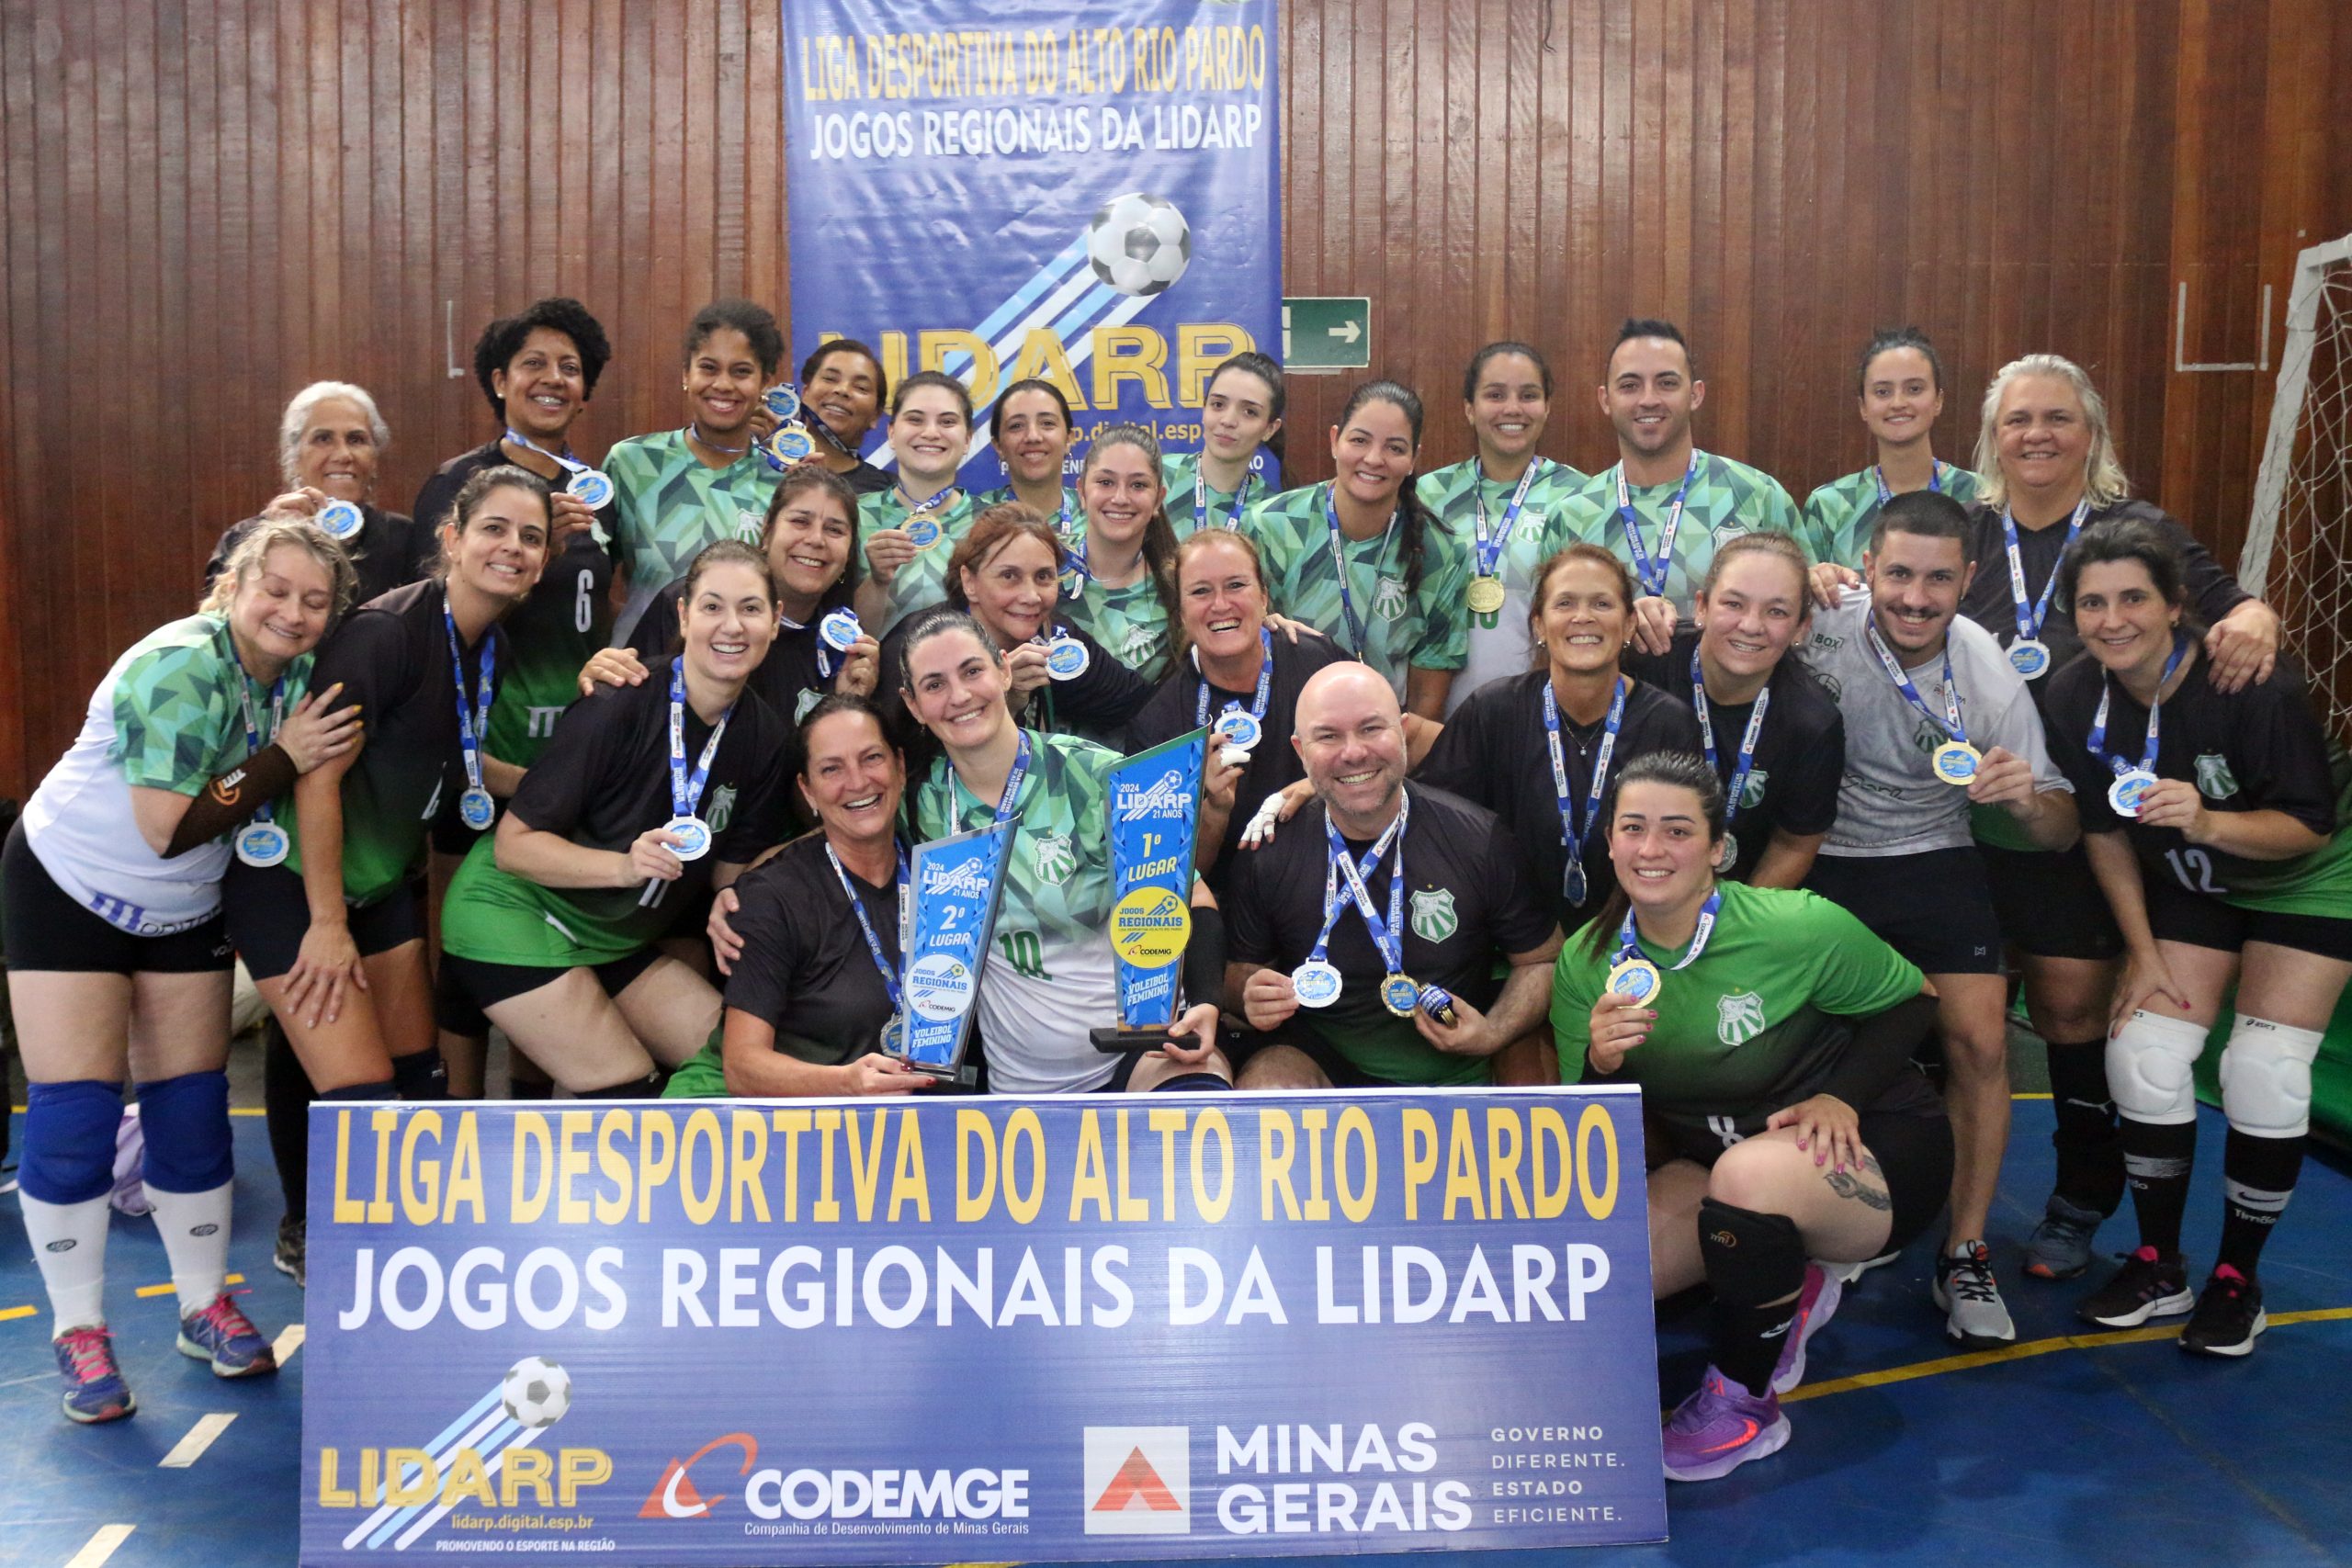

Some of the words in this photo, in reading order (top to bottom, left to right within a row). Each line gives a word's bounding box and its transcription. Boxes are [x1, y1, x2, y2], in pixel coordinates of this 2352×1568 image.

[803, 35, 860, 101] LIGA
[866, 28, 1017, 99] DESPORTIVA
[1023, 28, 1058, 96] DO
[1067, 28, 1126, 95] ALTO
[1134, 26, 1177, 92] RIO
[1185, 24, 1266, 91] PARDO
[810, 111, 914, 160] JOGOS
[924, 105, 1091, 156] REGIONAIS
[1102, 104, 1145, 151] DA
[1154, 103, 1261, 150] LIDARP
[575, 569, 594, 633] 6
[1008, 773, 1016, 787] ALTO
[1014, 767, 1023, 782] LIGA
[1003, 780, 1020, 815] DESPORTIVA
[1120, 784, 1139, 793] 2024
[999, 795, 1009, 813] PARDO
[1117, 793, 1192, 809] LIDARP
[1152, 809, 1161, 818] 21
[1162, 809, 1182, 818] ANOS
[926, 862, 944, 872] 2024
[1127, 856, 1178, 882] LUGAR
[1341, 860, 1355, 881] CODEMIG
[2165, 849, 2227, 894] 12
[922, 870, 989, 891] LIDARP
[953, 888, 960, 897] 21
[961, 889, 979, 899] ANOS
[1353, 888, 1366, 908] GERAIS
[1357, 886, 1369, 904] MINAS
[1118, 917, 1182, 927] REGIONAIS
[929, 932, 971, 947] LUGAR
[1697, 922, 1706, 945] CODEMIG
[999, 931, 1053, 982] 10
[1375, 934, 1395, 966] REGIONAIS
[913, 967, 935, 976] JOGOS
[912, 976, 967, 991] REGIONAIS
[1128, 973, 1169, 995] VOLEIBOL
[1127, 983, 1169, 1007] FEMININO
[929, 1004, 956, 1012] CODEMIG
[914, 1024, 952, 1039] VOLEIBOL
[2254, 1021, 2277, 1031] asics
[912, 1034, 952, 1048] FEMININO
[333, 1109, 486, 1226] LIGA
[511, 1107, 932, 1226] DESPORTIVA
[956, 1107, 1046, 1224] DO
[1069, 1107, 1235, 1224] ALTO
[1260, 1105, 1377, 1223] RIO
[1402, 1104, 1619, 1222] PARDO
[339, 1246, 628, 1331] JOGOS
[662, 1245, 1134, 1329] REGIONAIS
[1169, 1244, 1288, 1325] DA
[1317, 1243, 1611, 1325] LIDARP
[1491, 1426, 1603, 1442] GOVERNO
[1217, 1422, 1438, 1474] MINAS
[1492, 1453, 1625, 1469] DIFERENTE.
[318, 1448, 613, 1508] LIDARP
[745, 1468, 1029, 1520] CODEMGE
[1493, 1480, 1583, 1496] ESTADO
[1216, 1480, 1473, 1535] GERAIS
[1494, 1506, 1623, 1524] EFICIENTE.
[451, 1514, 594, 1532] lidarp.digital.esp.br
[745, 1522, 809, 1537] Companhia
[814, 1522, 828, 1535] de
[832, 1522, 932, 1535] Desenvolvimento
[935, 1522, 949, 1535] de
[953, 1522, 989, 1535] Minas
[992, 1522, 1029, 1535] Gerais
[435, 1540, 503, 1551] PROMOVENDO
[506, 1540, 514, 1551] O
[516, 1540, 559, 1551] ESPORTE
[561, 1540, 575, 1551] NA
[578, 1537, 616, 1551] REGIÃO
